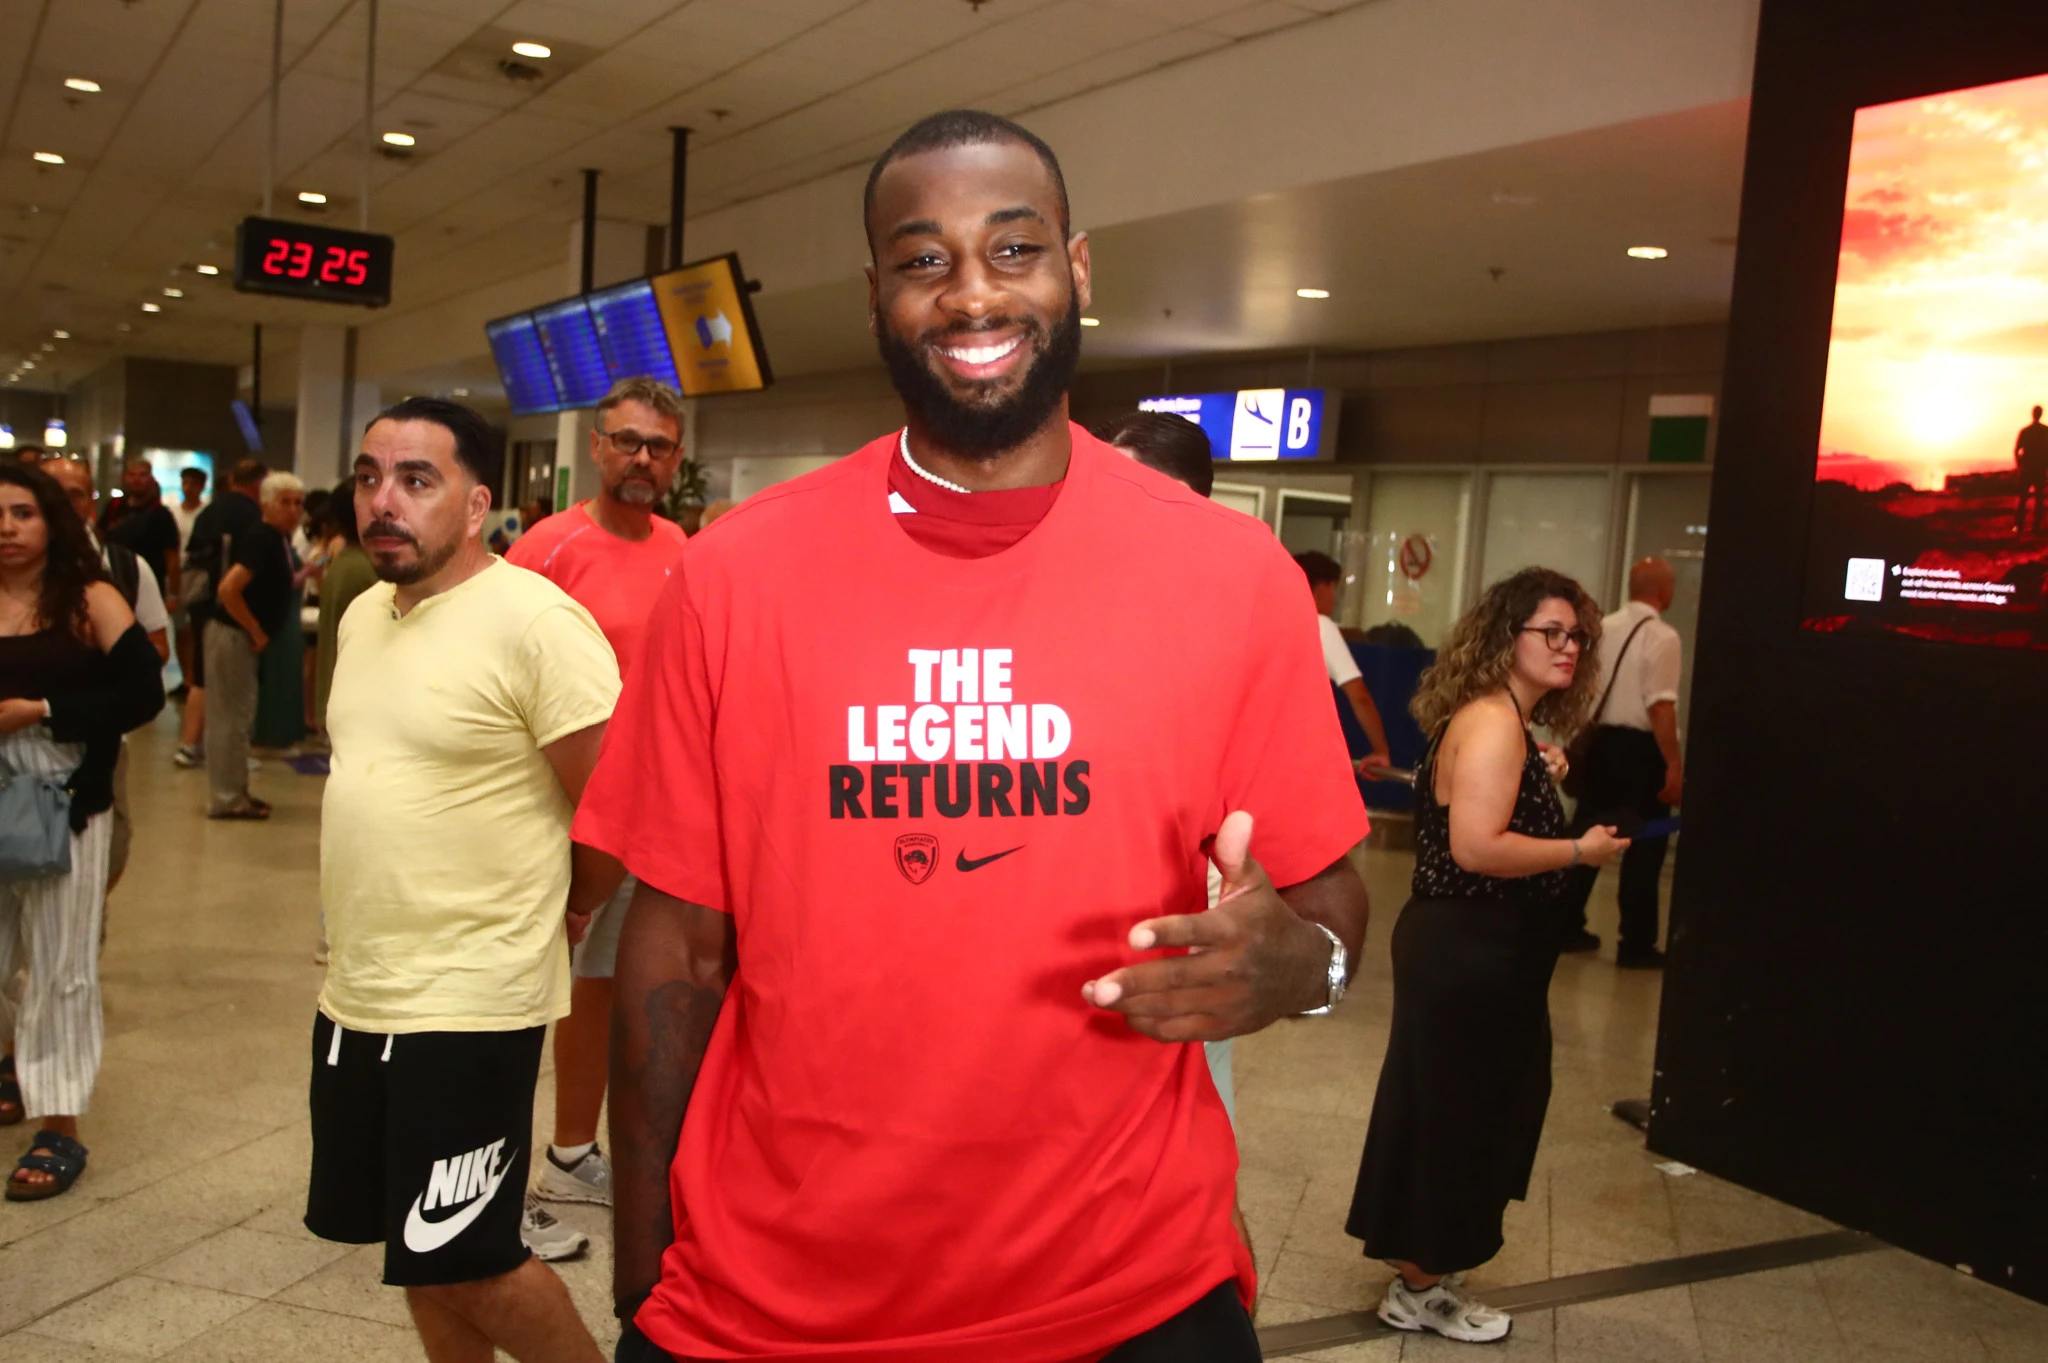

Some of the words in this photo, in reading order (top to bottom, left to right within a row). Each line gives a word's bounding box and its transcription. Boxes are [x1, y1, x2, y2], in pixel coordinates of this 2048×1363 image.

[262, 238, 314, 279] 23
[320, 245, 370, 286] 25
[1286, 398, 1312, 450] B
[908, 648, 1013, 703] THE
[848, 704, 1072, 762] LEGEND
[829, 760, 1091, 819] RETURNS
[423, 1137, 506, 1211] NIKE
